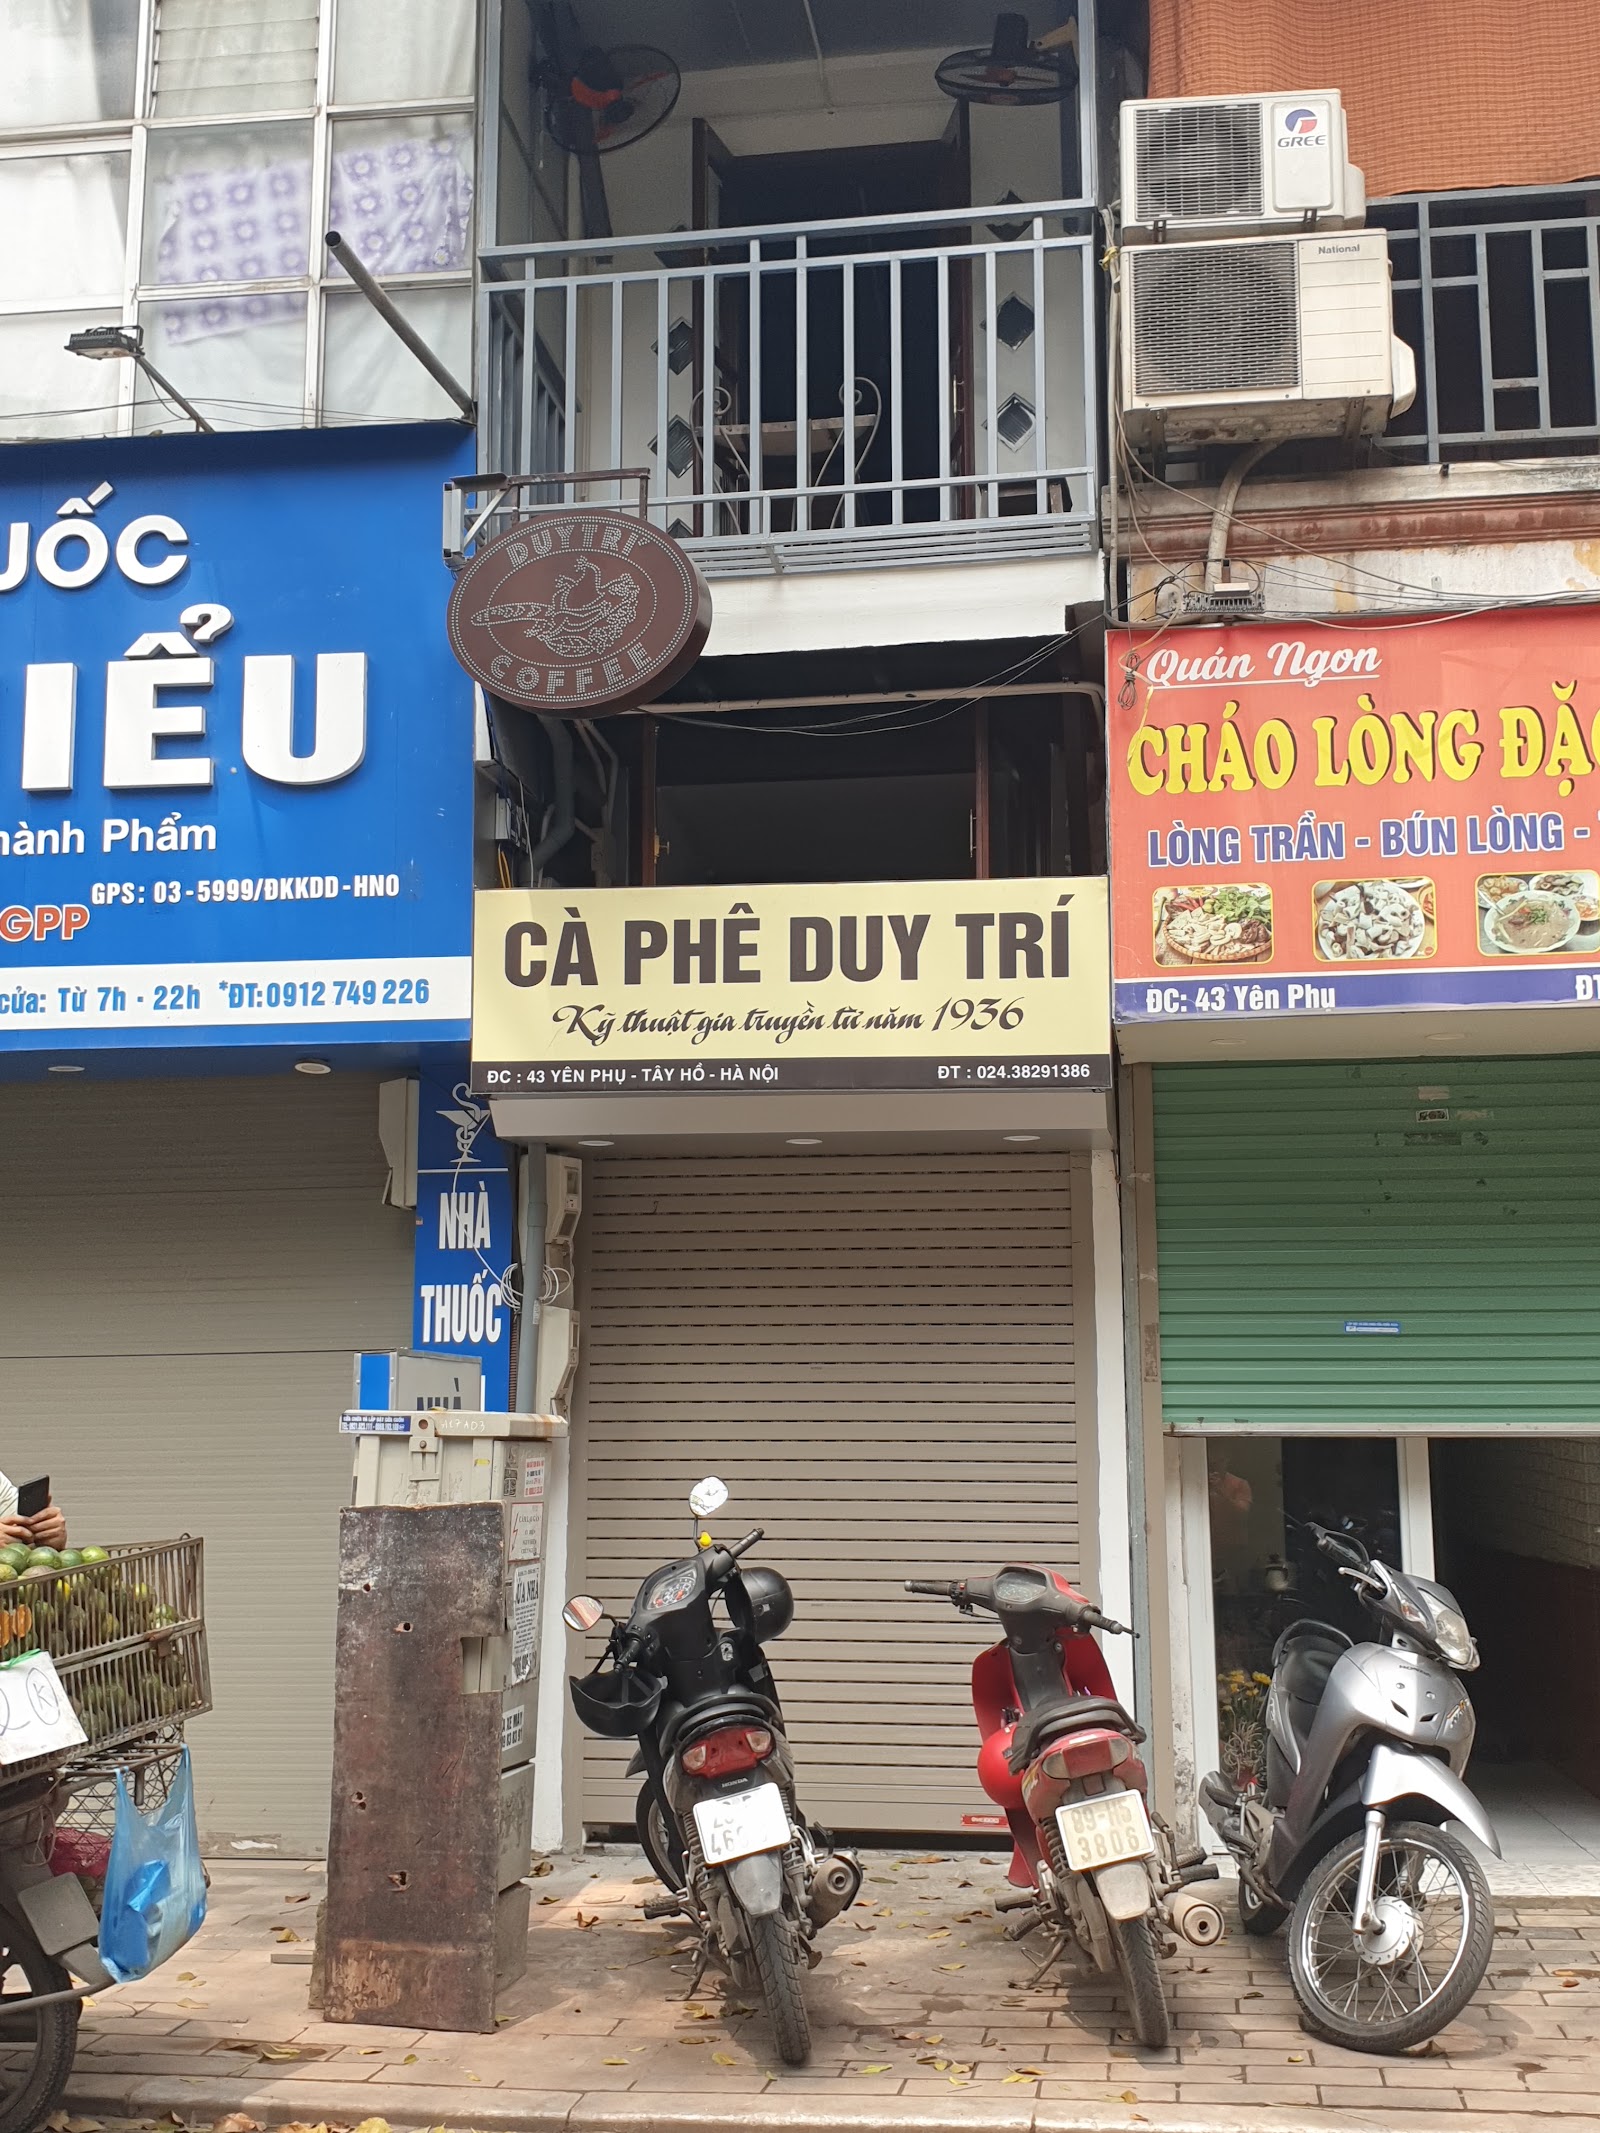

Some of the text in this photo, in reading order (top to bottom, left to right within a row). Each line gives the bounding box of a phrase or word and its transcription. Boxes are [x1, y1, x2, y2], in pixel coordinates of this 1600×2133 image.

[1277, 134, 1327, 148] GREE
[1318, 243, 1360, 256] National
[490, 641, 652, 695] COFFEE
[1147, 641, 1382, 687] Quán Ngon
[22, 603, 368, 791] IỂU
[1127, 680, 1600, 798] CHÁO LÒNG ĐẶ
[103, 812, 217, 853] Phẩm
[1147, 806, 1565, 868] LÒNG TRẦN BÚN LÒNG
[91, 882, 145, 904] GPS:
[0, 904, 91, 942] GPP
[503, 893, 1075, 987] CÀ PHÊ DUY TRÍ
[0, 985, 47, 1014] cửa:
[57, 985, 88, 1012] Từ
[97, 987, 126, 1012] 7h
[153, 984, 201, 1010] 22h
[333, 979, 377, 1006] 749
[382, 978, 430, 1004] 226
[1146, 988, 1187, 1013] ĐC:
[1195, 986, 1225, 1012] 43
[1233, 985, 1279, 1010] Yên
[552, 996, 1025, 1047] Kỹ thuật gia truyền từ năm 1936
[487, 1062, 779, 1086] ĐC 43 YÊN PHỤ TÂY HỒ HÀ NỘI
[937, 1064, 1090, 1079] ĐT 024.38291386
[438, 1180, 492, 1250] NHÀ
[420, 1269, 502, 1344] THUỐC
[721, 1777, 748, 1788] HONDA
